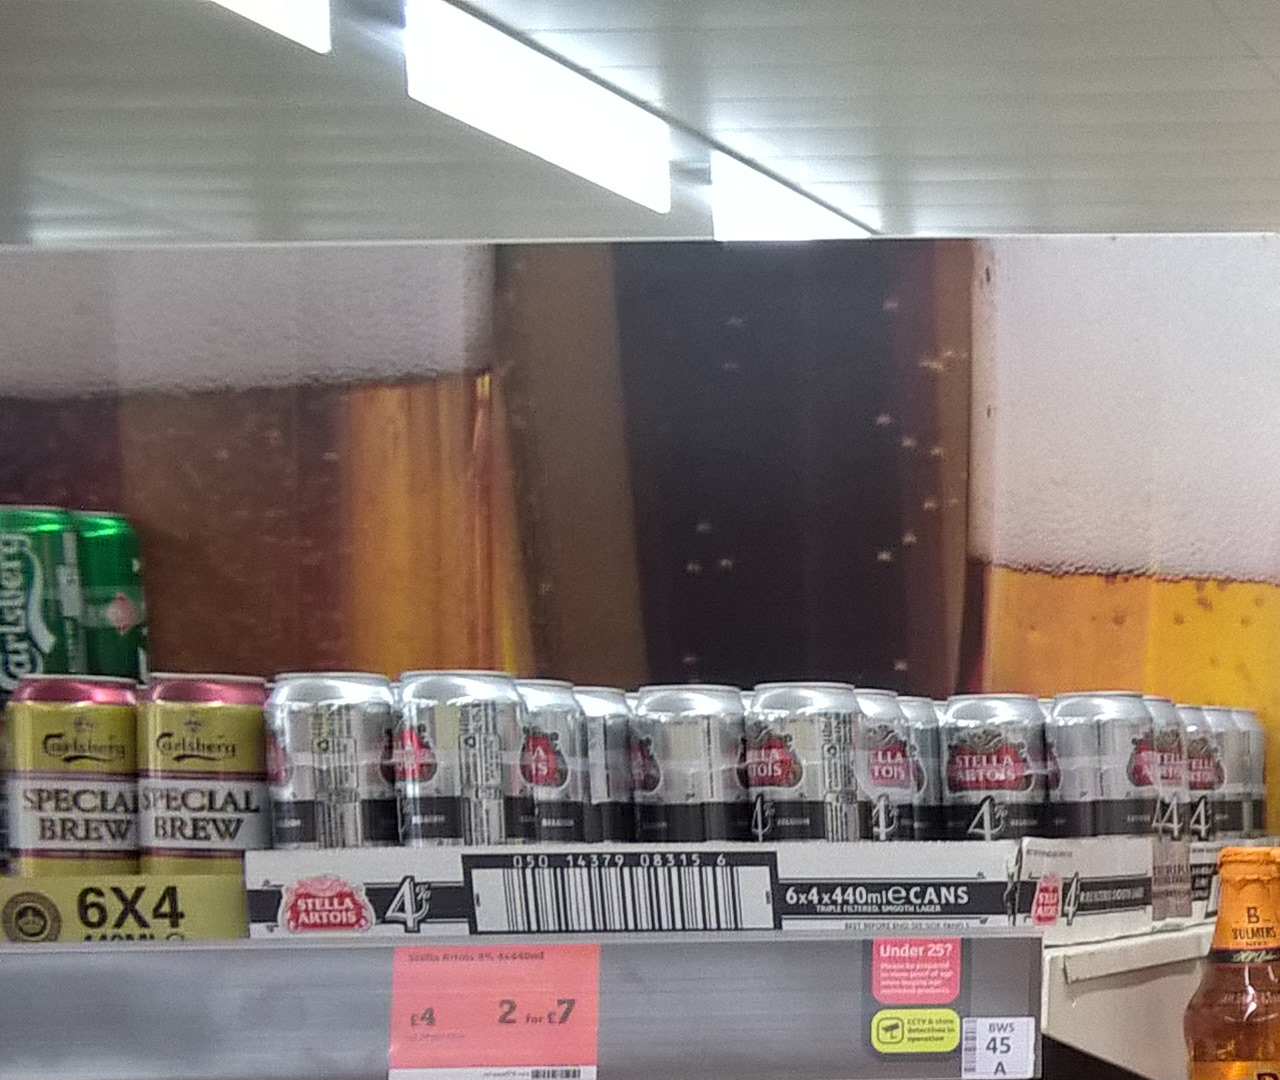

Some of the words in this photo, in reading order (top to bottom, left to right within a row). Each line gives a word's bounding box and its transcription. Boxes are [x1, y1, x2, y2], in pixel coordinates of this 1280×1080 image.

[43, 733, 127, 761] Carlsberg
[157, 732, 236, 760] Carlsberg
[139, 787, 260, 813] SPECIAL
[39, 817, 133, 840] BREW
[154, 817, 243, 840] BREW
[513, 856, 548, 868] 050
[567, 855, 624, 868] 14379
[640, 853, 701, 866] 08315
[297, 898, 354, 910] STELLA
[910, 887, 969, 904] CANS
[77, 886, 184, 930] 6X4
[881, 904, 915, 912] SMOOTH
[916, 904, 941, 912] LAGER
[298, 911, 356, 924] ARTOIS
[880, 944, 924, 957] Under
[928, 944, 953, 956] 25?
[411, 1007, 435, 1026] £4
[499, 1000, 516, 1024] 2
[526, 1014, 542, 1024] for
[547, 999, 576, 1024] £7
[989, 1023, 1014, 1033] BWS
[986, 1037, 1011, 1054] 45
[994, 1061, 1006, 1075] A
